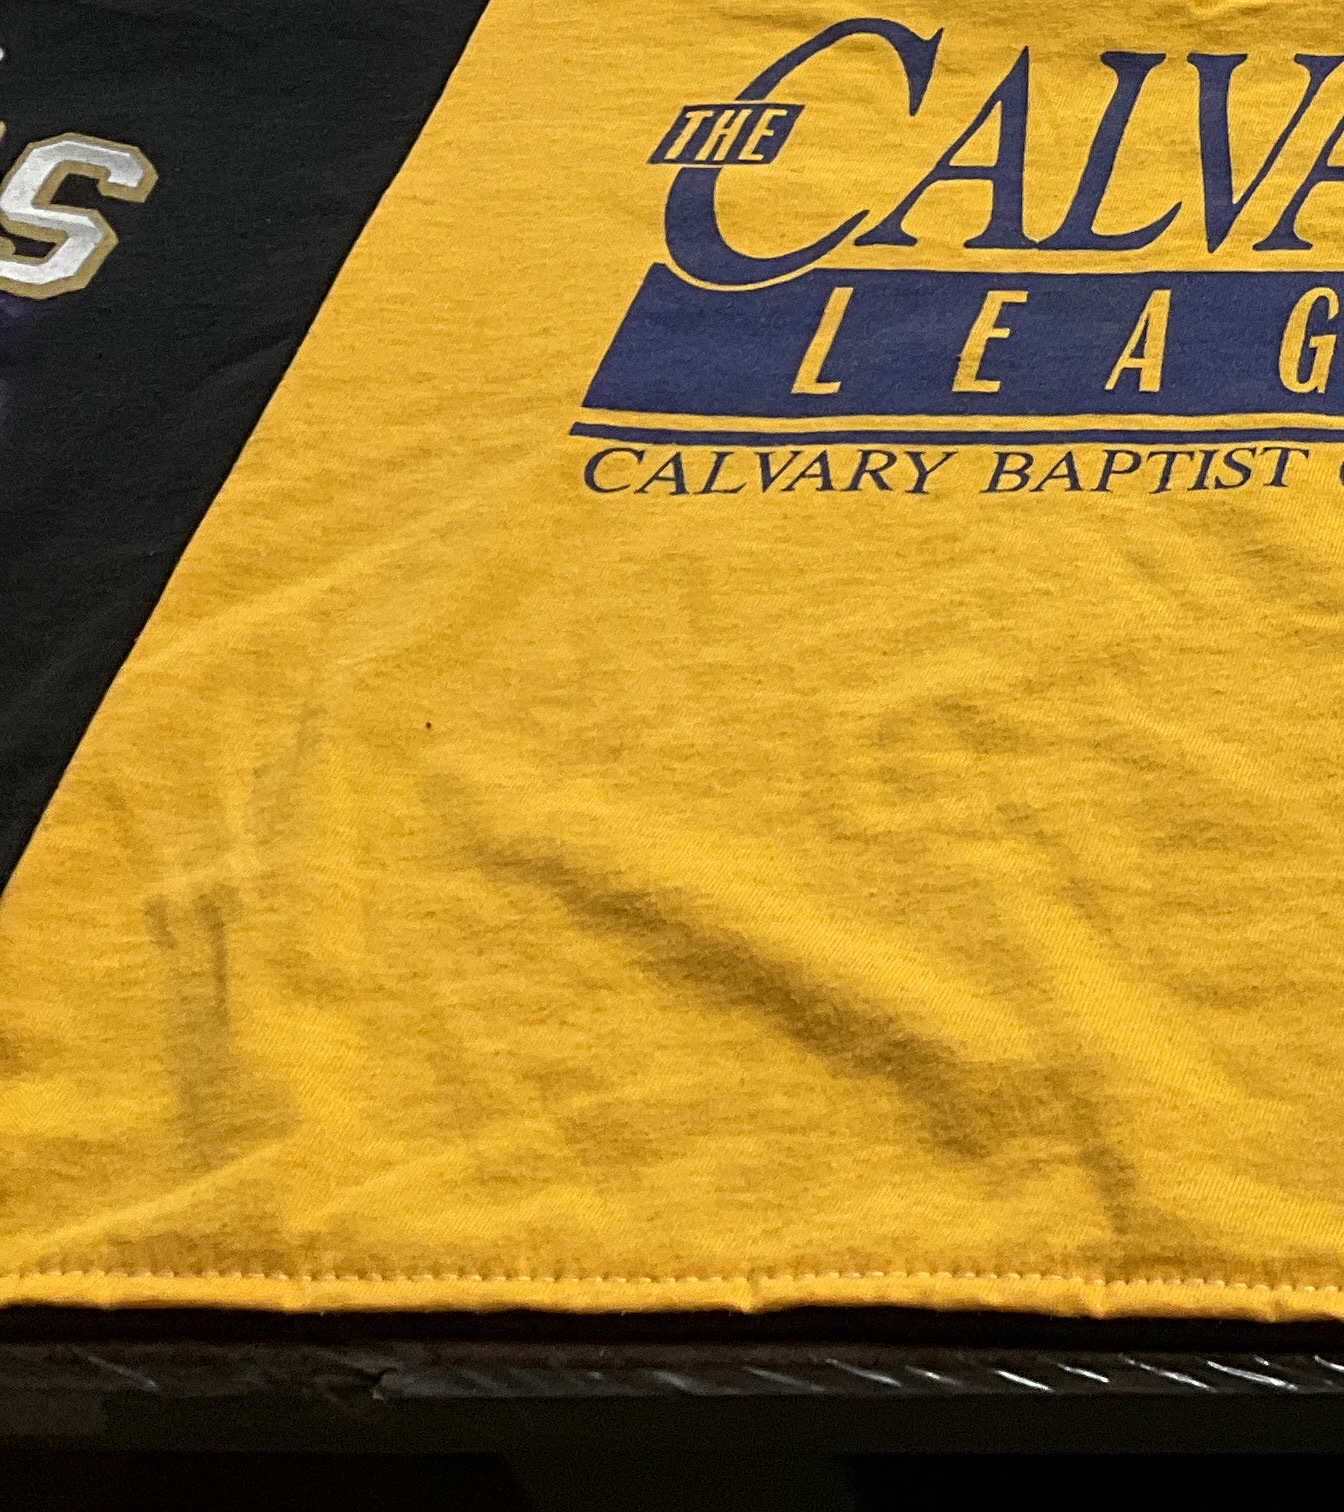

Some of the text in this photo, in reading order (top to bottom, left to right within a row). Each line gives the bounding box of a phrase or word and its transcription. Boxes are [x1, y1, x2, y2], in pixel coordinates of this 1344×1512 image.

[672, 108, 780, 165] THE
[583, 446, 960, 495] CALVARY
[980, 445, 1317, 493] BAPTIST
